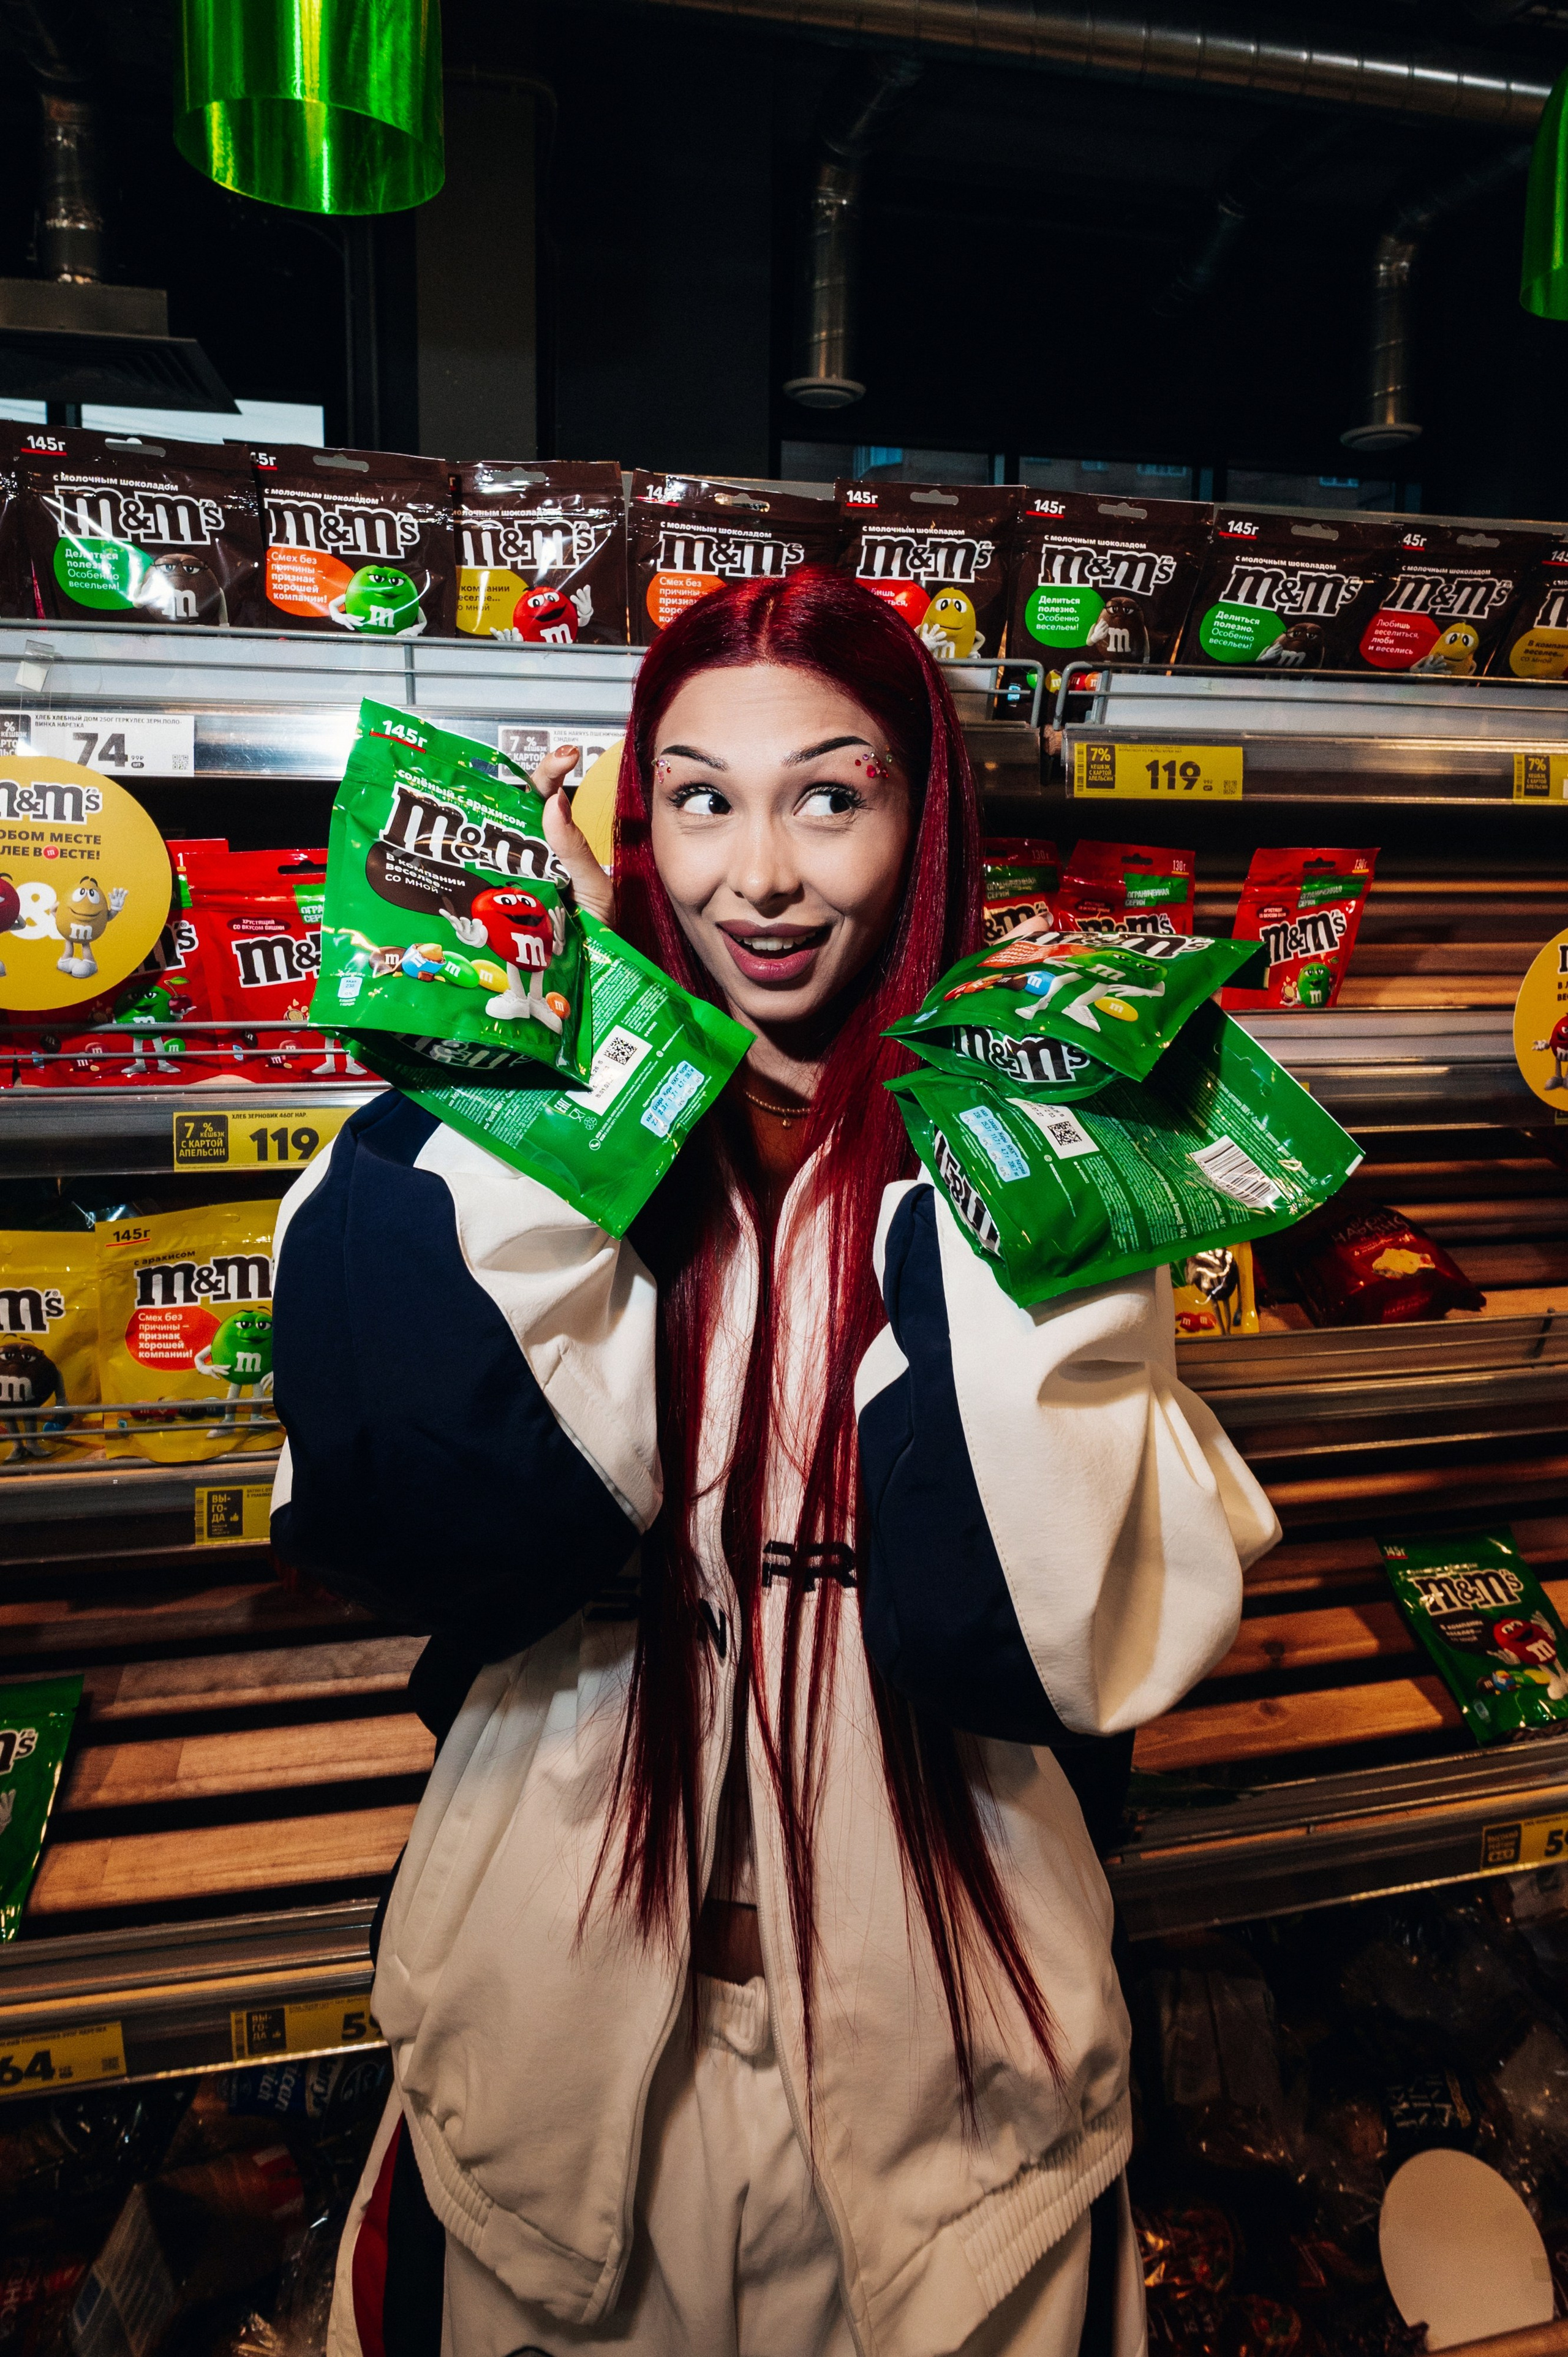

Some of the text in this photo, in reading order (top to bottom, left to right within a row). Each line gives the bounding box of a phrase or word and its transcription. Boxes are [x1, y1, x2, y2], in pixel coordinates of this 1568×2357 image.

[27, 436, 66, 451] 145г
[61, 474, 118, 485] молочным
[271, 489, 322, 500] молочным
[323, 494, 379, 505] шоколадом
[846, 490, 878, 504] 145г
[1034, 499, 1066, 515] 145г
[667, 522, 717, 534] молочным
[718, 527, 772, 538] шоколадом
[869, 526, 914, 535] молочным
[1227, 521, 1259, 536] 145г
[1050, 535, 1096, 545] молочным
[1098, 540, 1146, 549] шоколадом
[1403, 534, 1427, 548] 45г
[271, 551, 317, 565] Смех без
[1242, 556, 1286, 567] молочным
[1288, 560, 1336, 571] шоколадом
[271, 562, 315, 576] причины
[1408, 566, 1447, 575] молочным
[272, 573, 315, 584] признак
[659, 576, 703, 587] Смех без
[272, 583, 320, 595] хорошей
[273, 593, 327, 605] компании!
[1039, 595, 1080, 605] Делиться
[370, 606, 396, 628] m
[1038, 606, 1077, 614] полезно.
[1037, 613, 1079, 623] Особенно
[1215, 610, 1260, 625] Делиться
[1376, 619, 1411, 630] Любишь
[1036, 623, 1079, 632] весельем!
[1213, 620, 1254, 633] полезно.
[1107, 628, 1131, 653] m
[1212, 627, 1254, 643] Особенно
[1374, 628, 1419, 640] веселиться,
[1209, 637, 1252, 651] весельем!
[1370, 637, 1394, 646] люби
[1375, 644, 1413, 656] веселись
[383, 720, 428, 748] 145г
[72, 733, 128, 767] 74
[510, 736, 519, 751] 7
[1091, 748, 1111, 761] 7%
[1145, 760, 1200, 790] 119
[398, 769, 454, 798] солёный
[465, 798, 526, 828] арахисом
[50, 832, 102, 845] МЕСТЕ
[386, 853, 466, 887] В компании
[385, 874, 439, 894] со мной
[511, 932, 548, 966] m
[184, 1123, 194, 1138] 7
[189, 1137, 223, 1148] КАРТОЙ
[249, 1127, 319, 1161] 119
[179, 1148, 225, 1157] АПЕЛЬСИН
[113, 1228, 151, 1243] 145г
[141, 1249, 195, 1265] арахисом
[138, 1312, 183, 1322] Смех без
[139, 1322, 180, 1332] причины
[138, 1332, 180, 1341] признак
[138, 1340, 184, 1350] хорошей
[138, 1349, 192, 1359] компании!
[235, 1351, 261, 1372] m
[212, 1494, 231, 1503] ВЫ-
[212, 1514, 225, 1523] ДА
